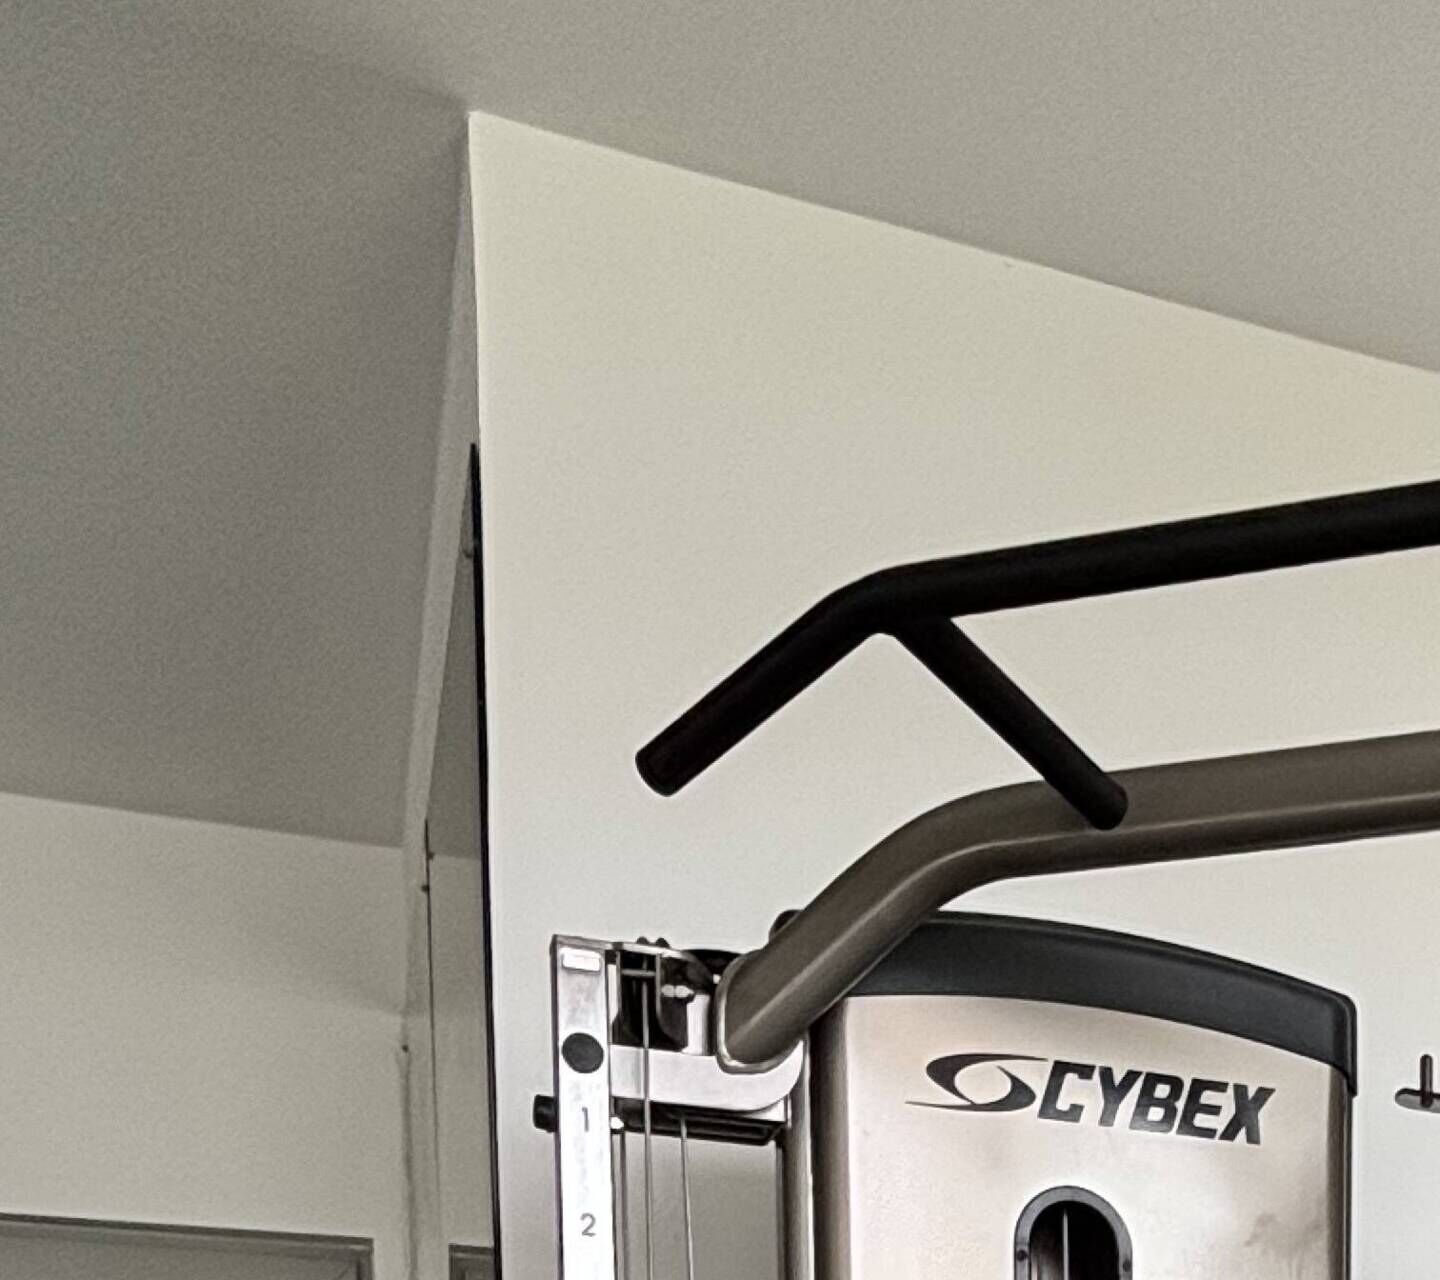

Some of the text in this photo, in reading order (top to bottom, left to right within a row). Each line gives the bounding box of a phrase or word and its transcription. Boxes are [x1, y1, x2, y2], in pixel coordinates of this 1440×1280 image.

[1036, 1059, 1276, 1145] CYBEX
[581, 1106, 591, 1133] 1
[580, 1213, 597, 1237] 2
